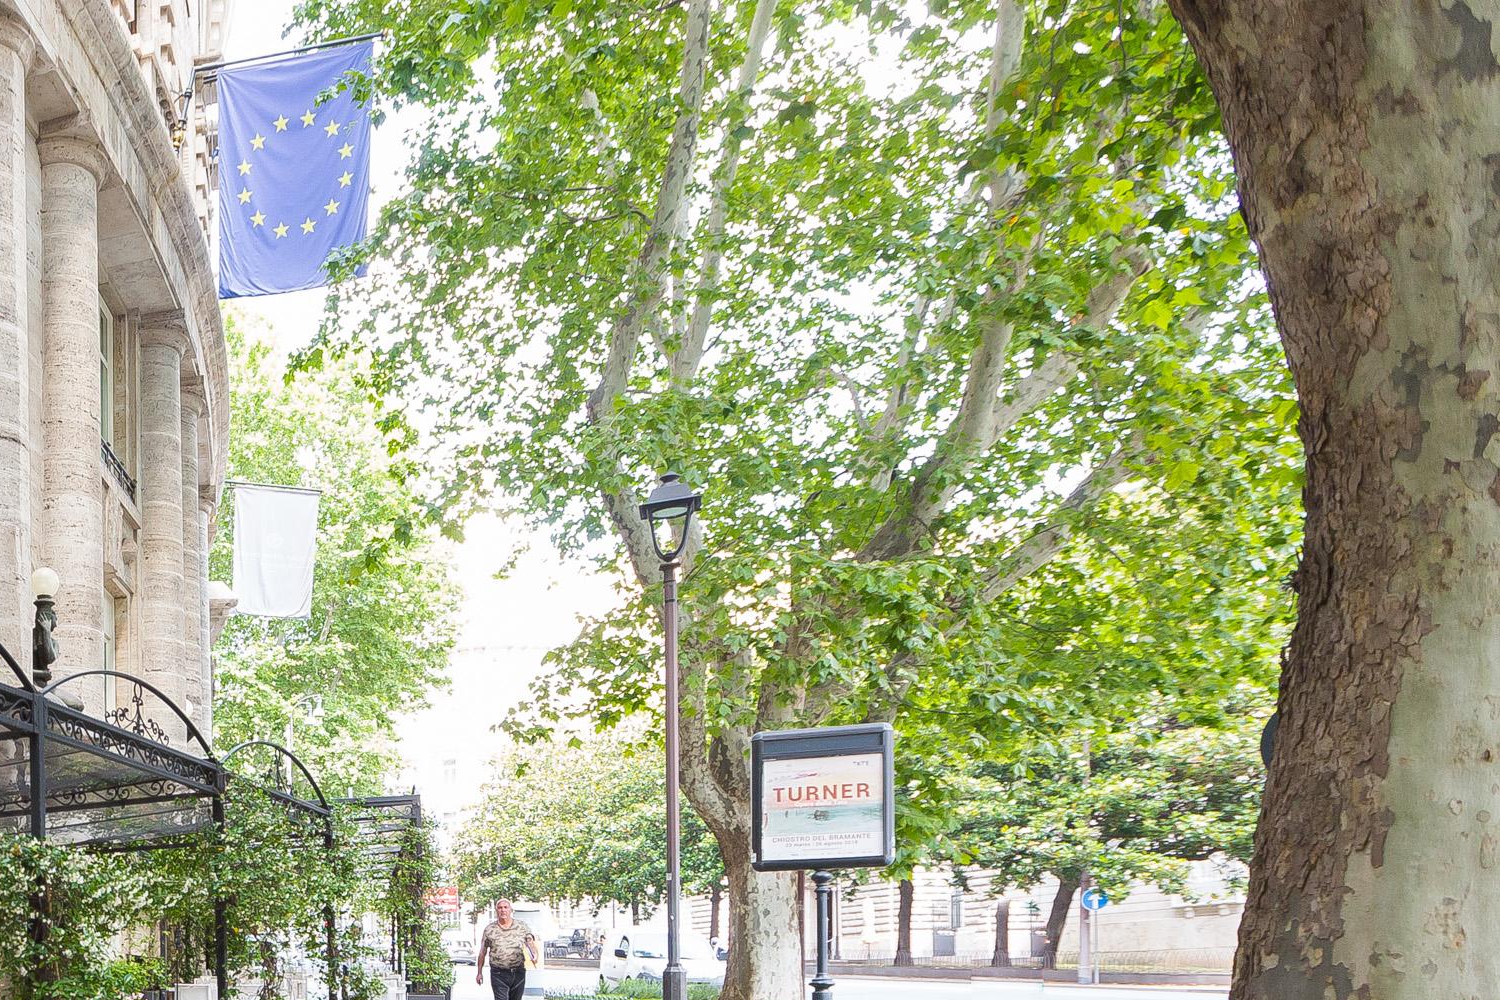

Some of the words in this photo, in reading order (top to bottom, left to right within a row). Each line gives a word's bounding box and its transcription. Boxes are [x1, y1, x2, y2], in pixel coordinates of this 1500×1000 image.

[772, 782, 870, 803] TURNER
[772, 836, 811, 844] CHIOSTRO
[828, 833, 871, 841] BRAMANTE
